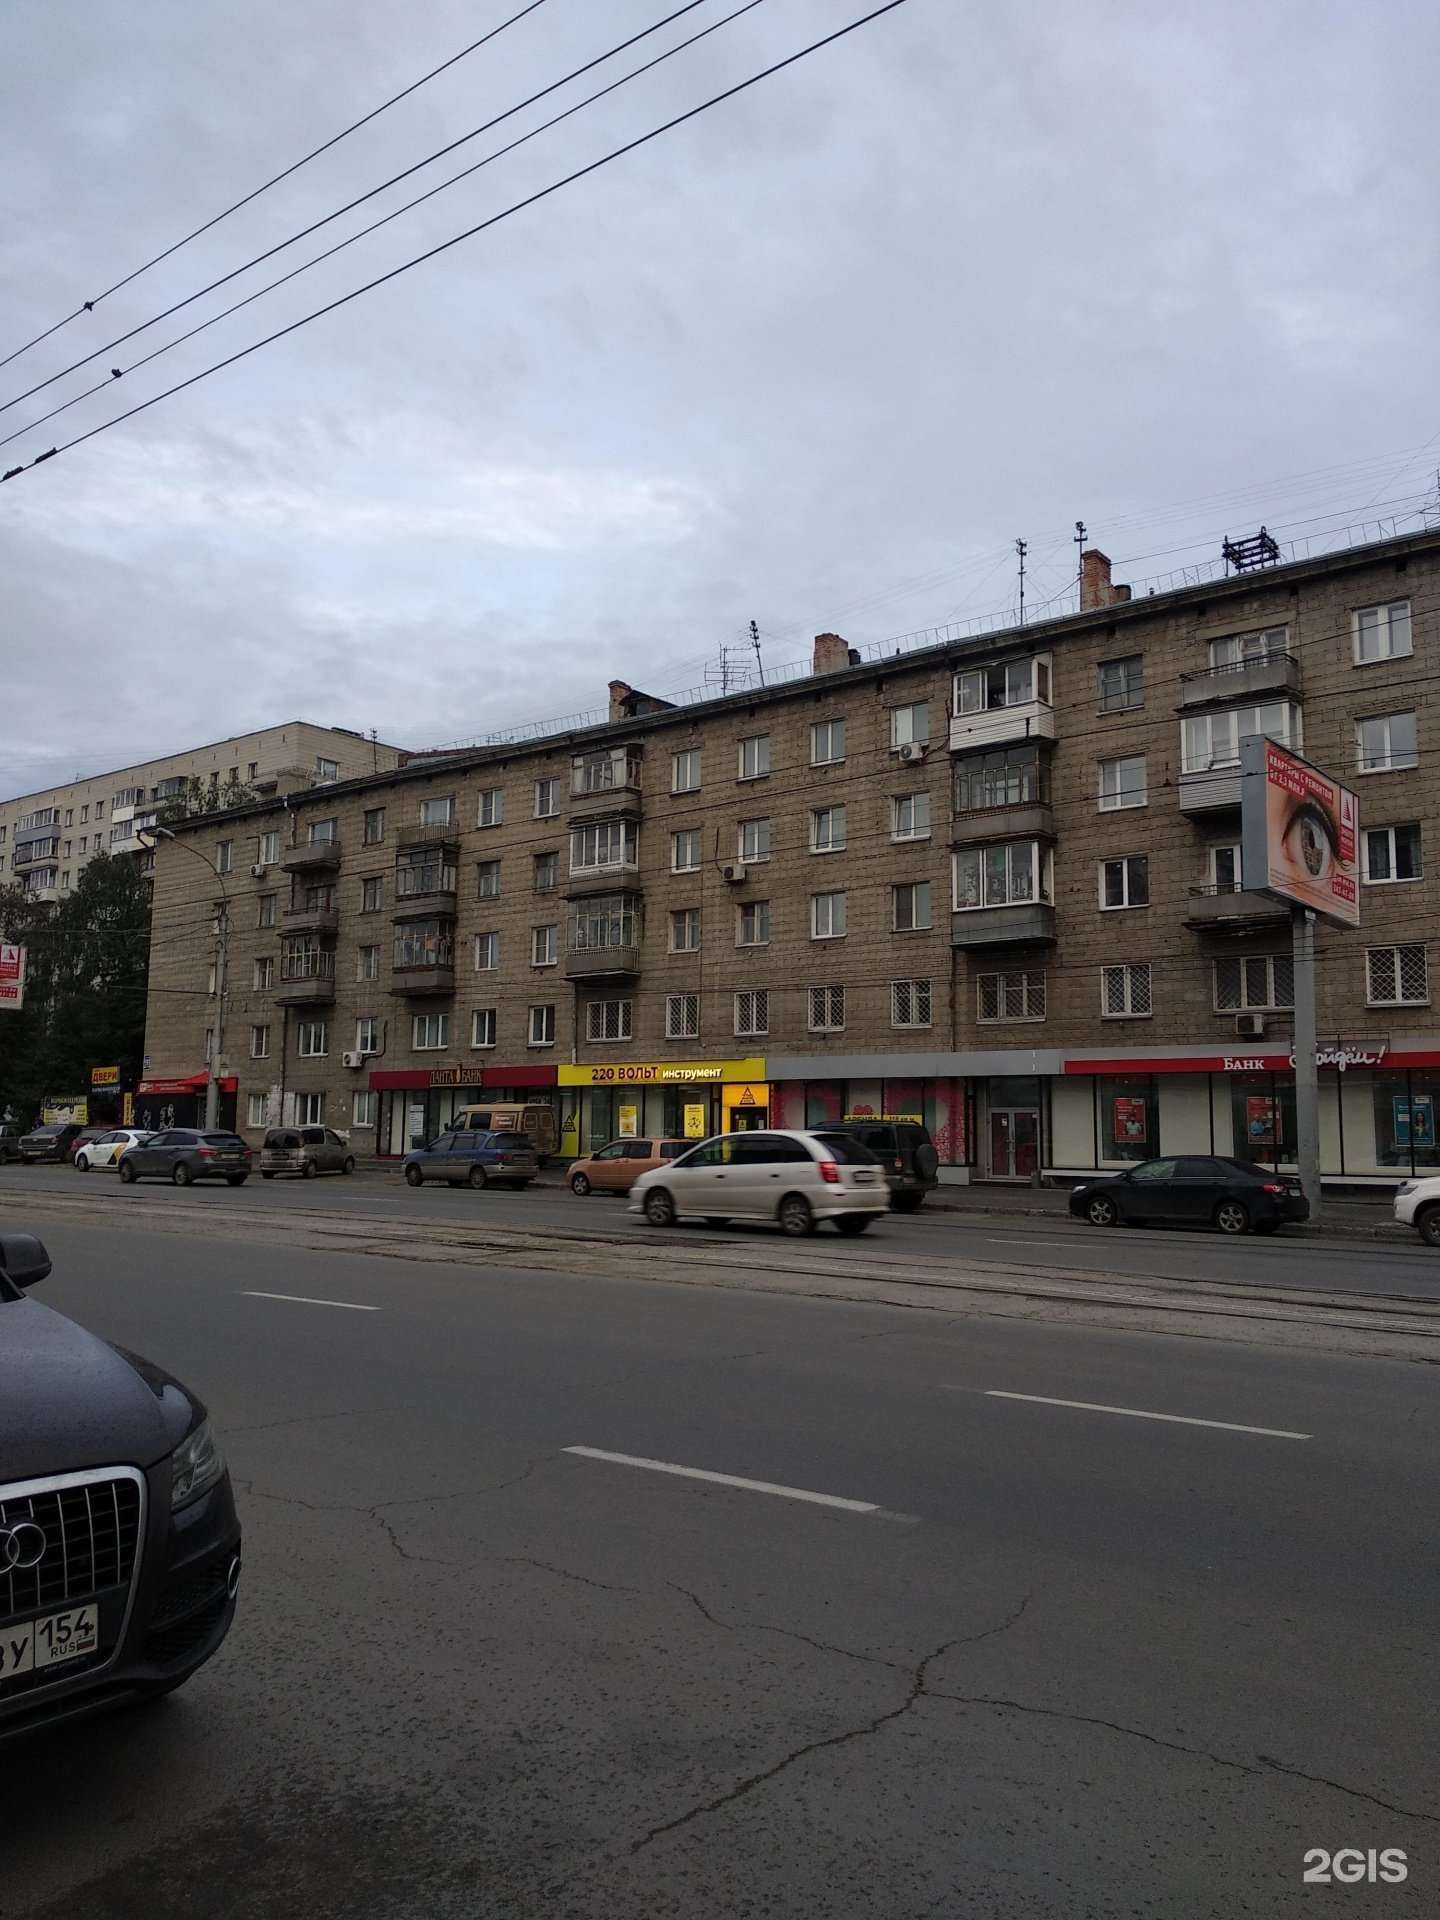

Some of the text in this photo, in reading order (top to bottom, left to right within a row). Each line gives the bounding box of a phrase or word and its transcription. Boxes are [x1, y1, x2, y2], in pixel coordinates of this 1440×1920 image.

[93, 1071, 117, 1082] ДВЕРИ
[592, 1067, 722, 1081] 220 ВОЛЬТ инструмент
[39, 1609, 93, 1648] 154
[50, 1641, 78, 1657] RUS
